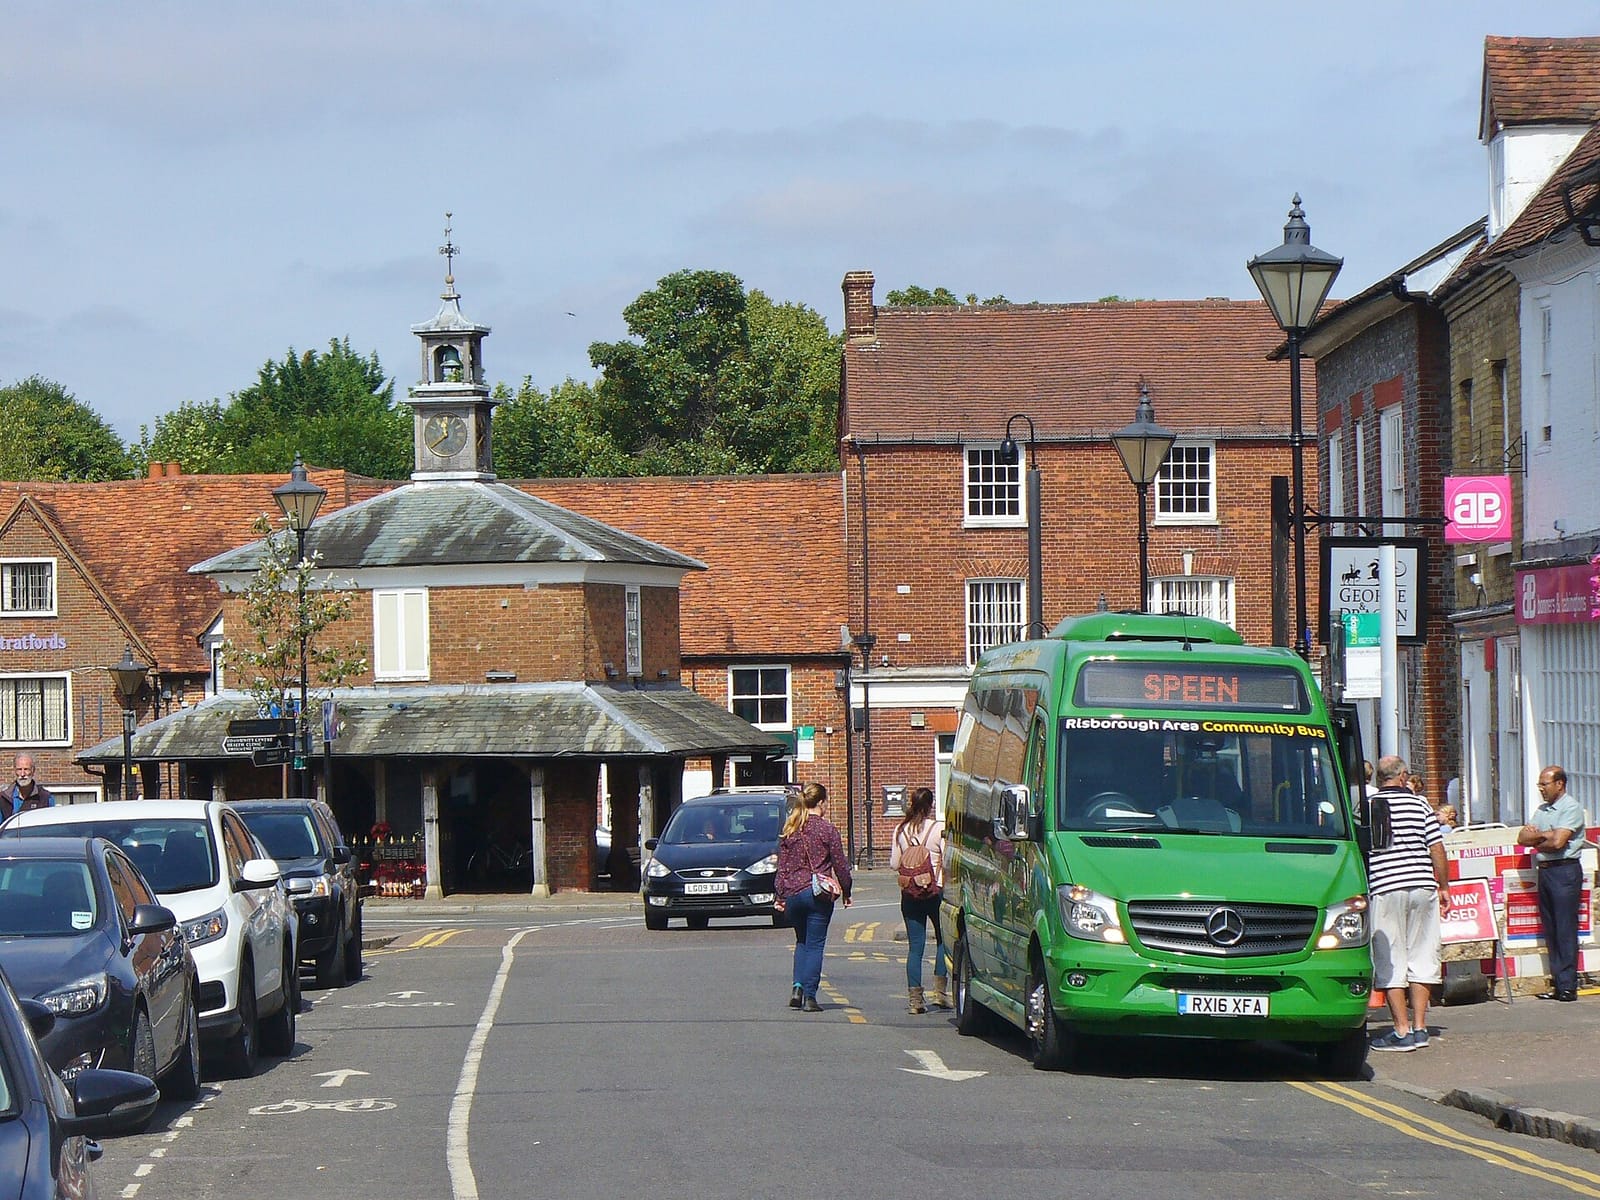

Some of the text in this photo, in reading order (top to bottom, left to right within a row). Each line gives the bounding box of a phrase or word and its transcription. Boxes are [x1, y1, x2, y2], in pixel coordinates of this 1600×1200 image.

[1340, 588, 1406, 603] GEOE
[0, 633, 67, 650] tratfords
[1144, 674, 1239, 703] SPEEN
[1065, 719, 1326, 738] Risborough Area Community Bus
[1192, 997, 1262, 1014] RX16 XFA
